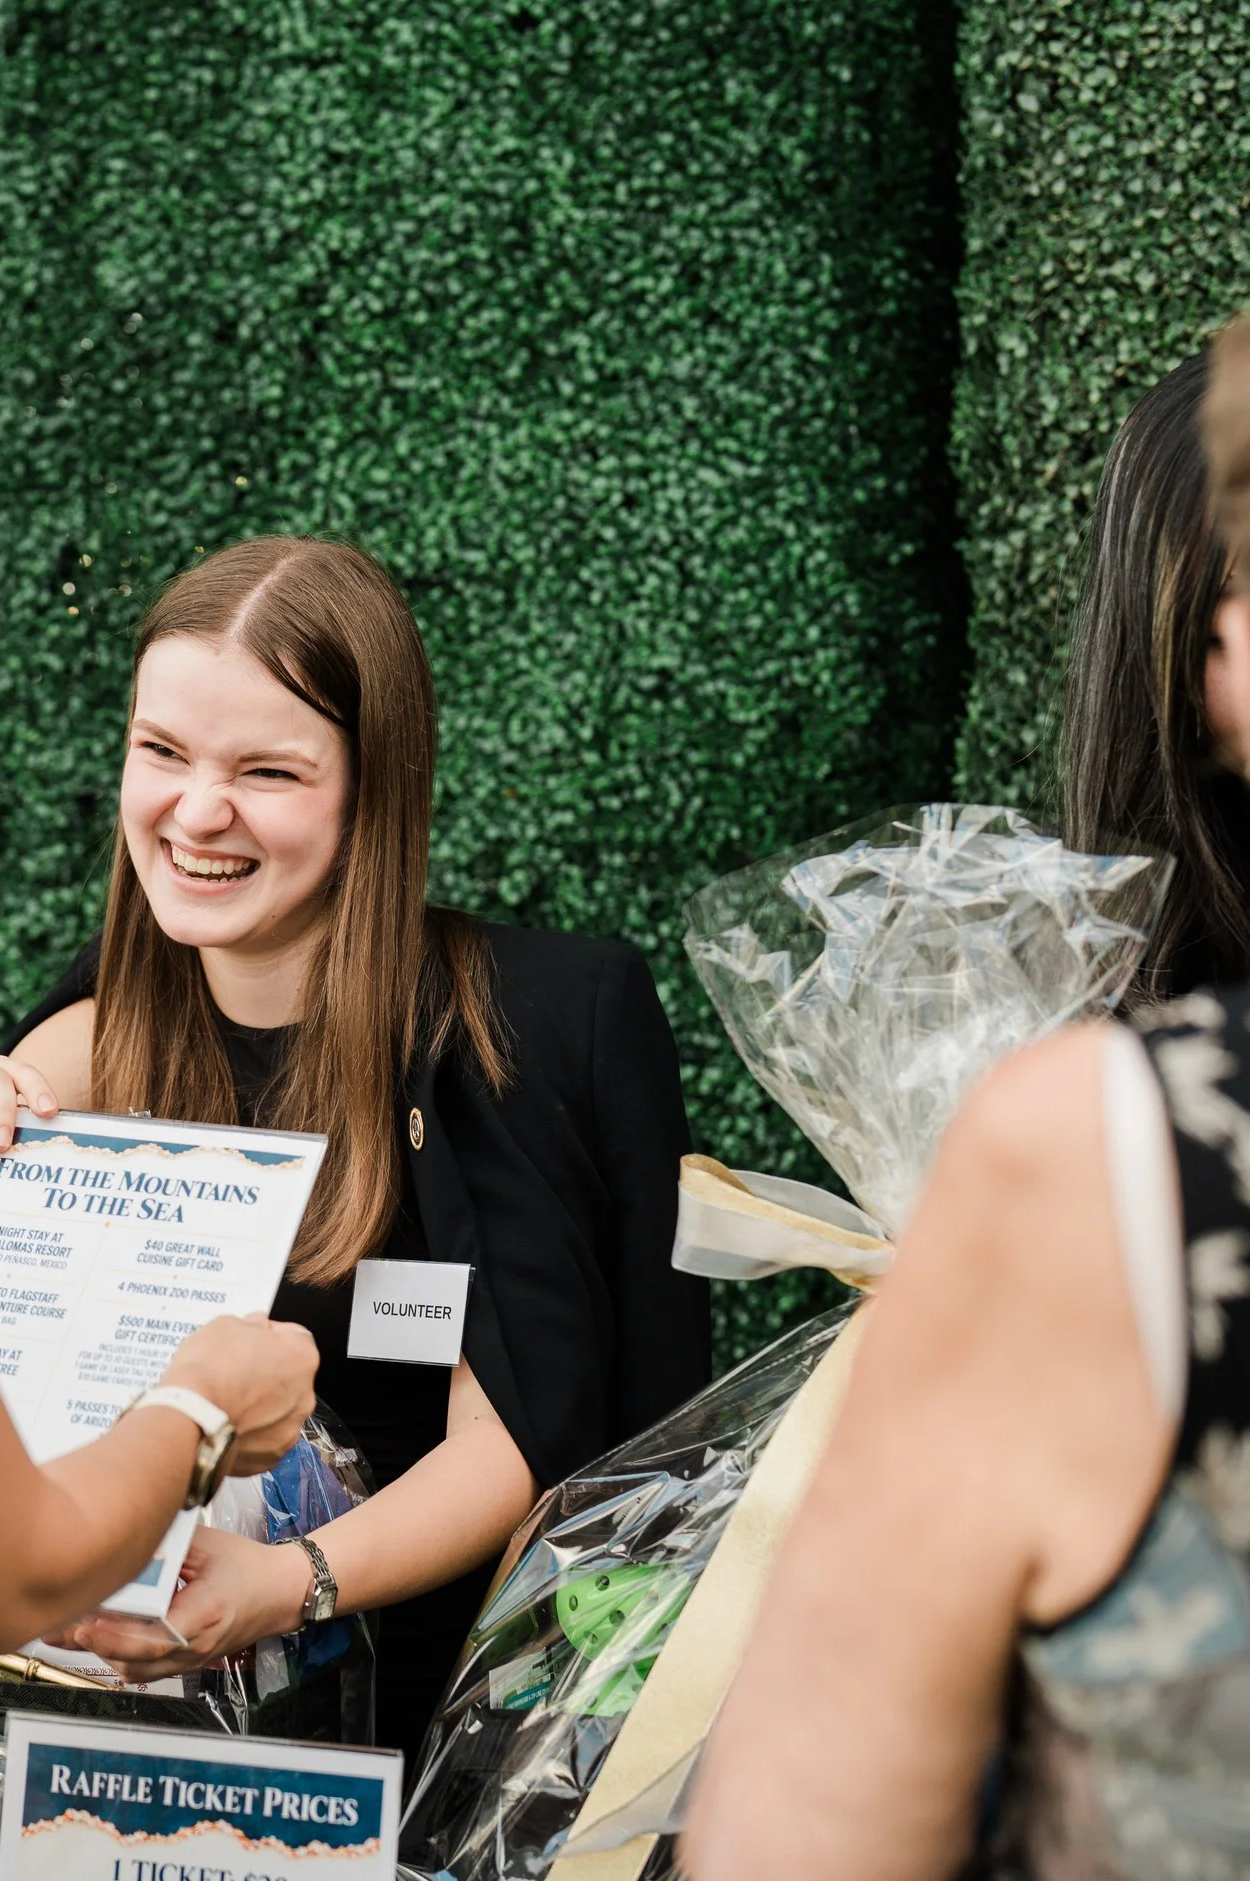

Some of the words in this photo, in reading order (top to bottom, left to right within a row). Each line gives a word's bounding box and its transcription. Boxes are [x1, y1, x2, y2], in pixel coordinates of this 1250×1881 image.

[69, 1167, 115, 1190] THE
[118, 1170, 260, 1205] MOUNTAINS
[43, 1187, 77, 1211] TO
[84, 1194, 133, 1217] THE
[137, 1198, 184, 1223] SEA
[27, 1229, 51, 1242] STAY
[50, 1233, 65, 1243] AT
[34, 1245, 73, 1258] RESORT
[144, 1239, 164, 1251] $40
[165, 1242, 195, 1254] GREAT
[197, 1245, 221, 1257] WALL
[137, 1253, 174, 1266] CUISINE
[175, 1257, 196, 1268] GIFT
[197, 1259, 224, 1272] CARD
[9, 1288, 59, 1304] FLAGSTAFF
[118, 1281, 126, 1291] 4
[126, 1282, 169, 1297] PHOENIX
[169, 1287, 189, 1299] ZOO
[189, 1289, 227, 1304] PASSES
[30, 1305, 67, 1319] COURSE
[373, 1301, 452, 1320] VOLUNTEER
[118, 1315, 144, 1328] $500
[145, 1318, 170, 1330] MAIN
[171, 1320, 204, 1335] EVEN
[115, 1329, 136, 1341] GIFT
[137, 1331, 186, 1347] CERTIFIC
[8, 1350, 22, 1361] AT
[66, 1398, 72, 1410] 5
[74, 1399, 109, 1414] PASSES
[70, 1413, 83, 1424] OF
[50, 1763, 152, 1804] RAFFLE
[158, 1775, 258, 1815] TICKET
[263, 1786, 359, 1827] PRICES
[114, 1858, 121, 1880] 1
